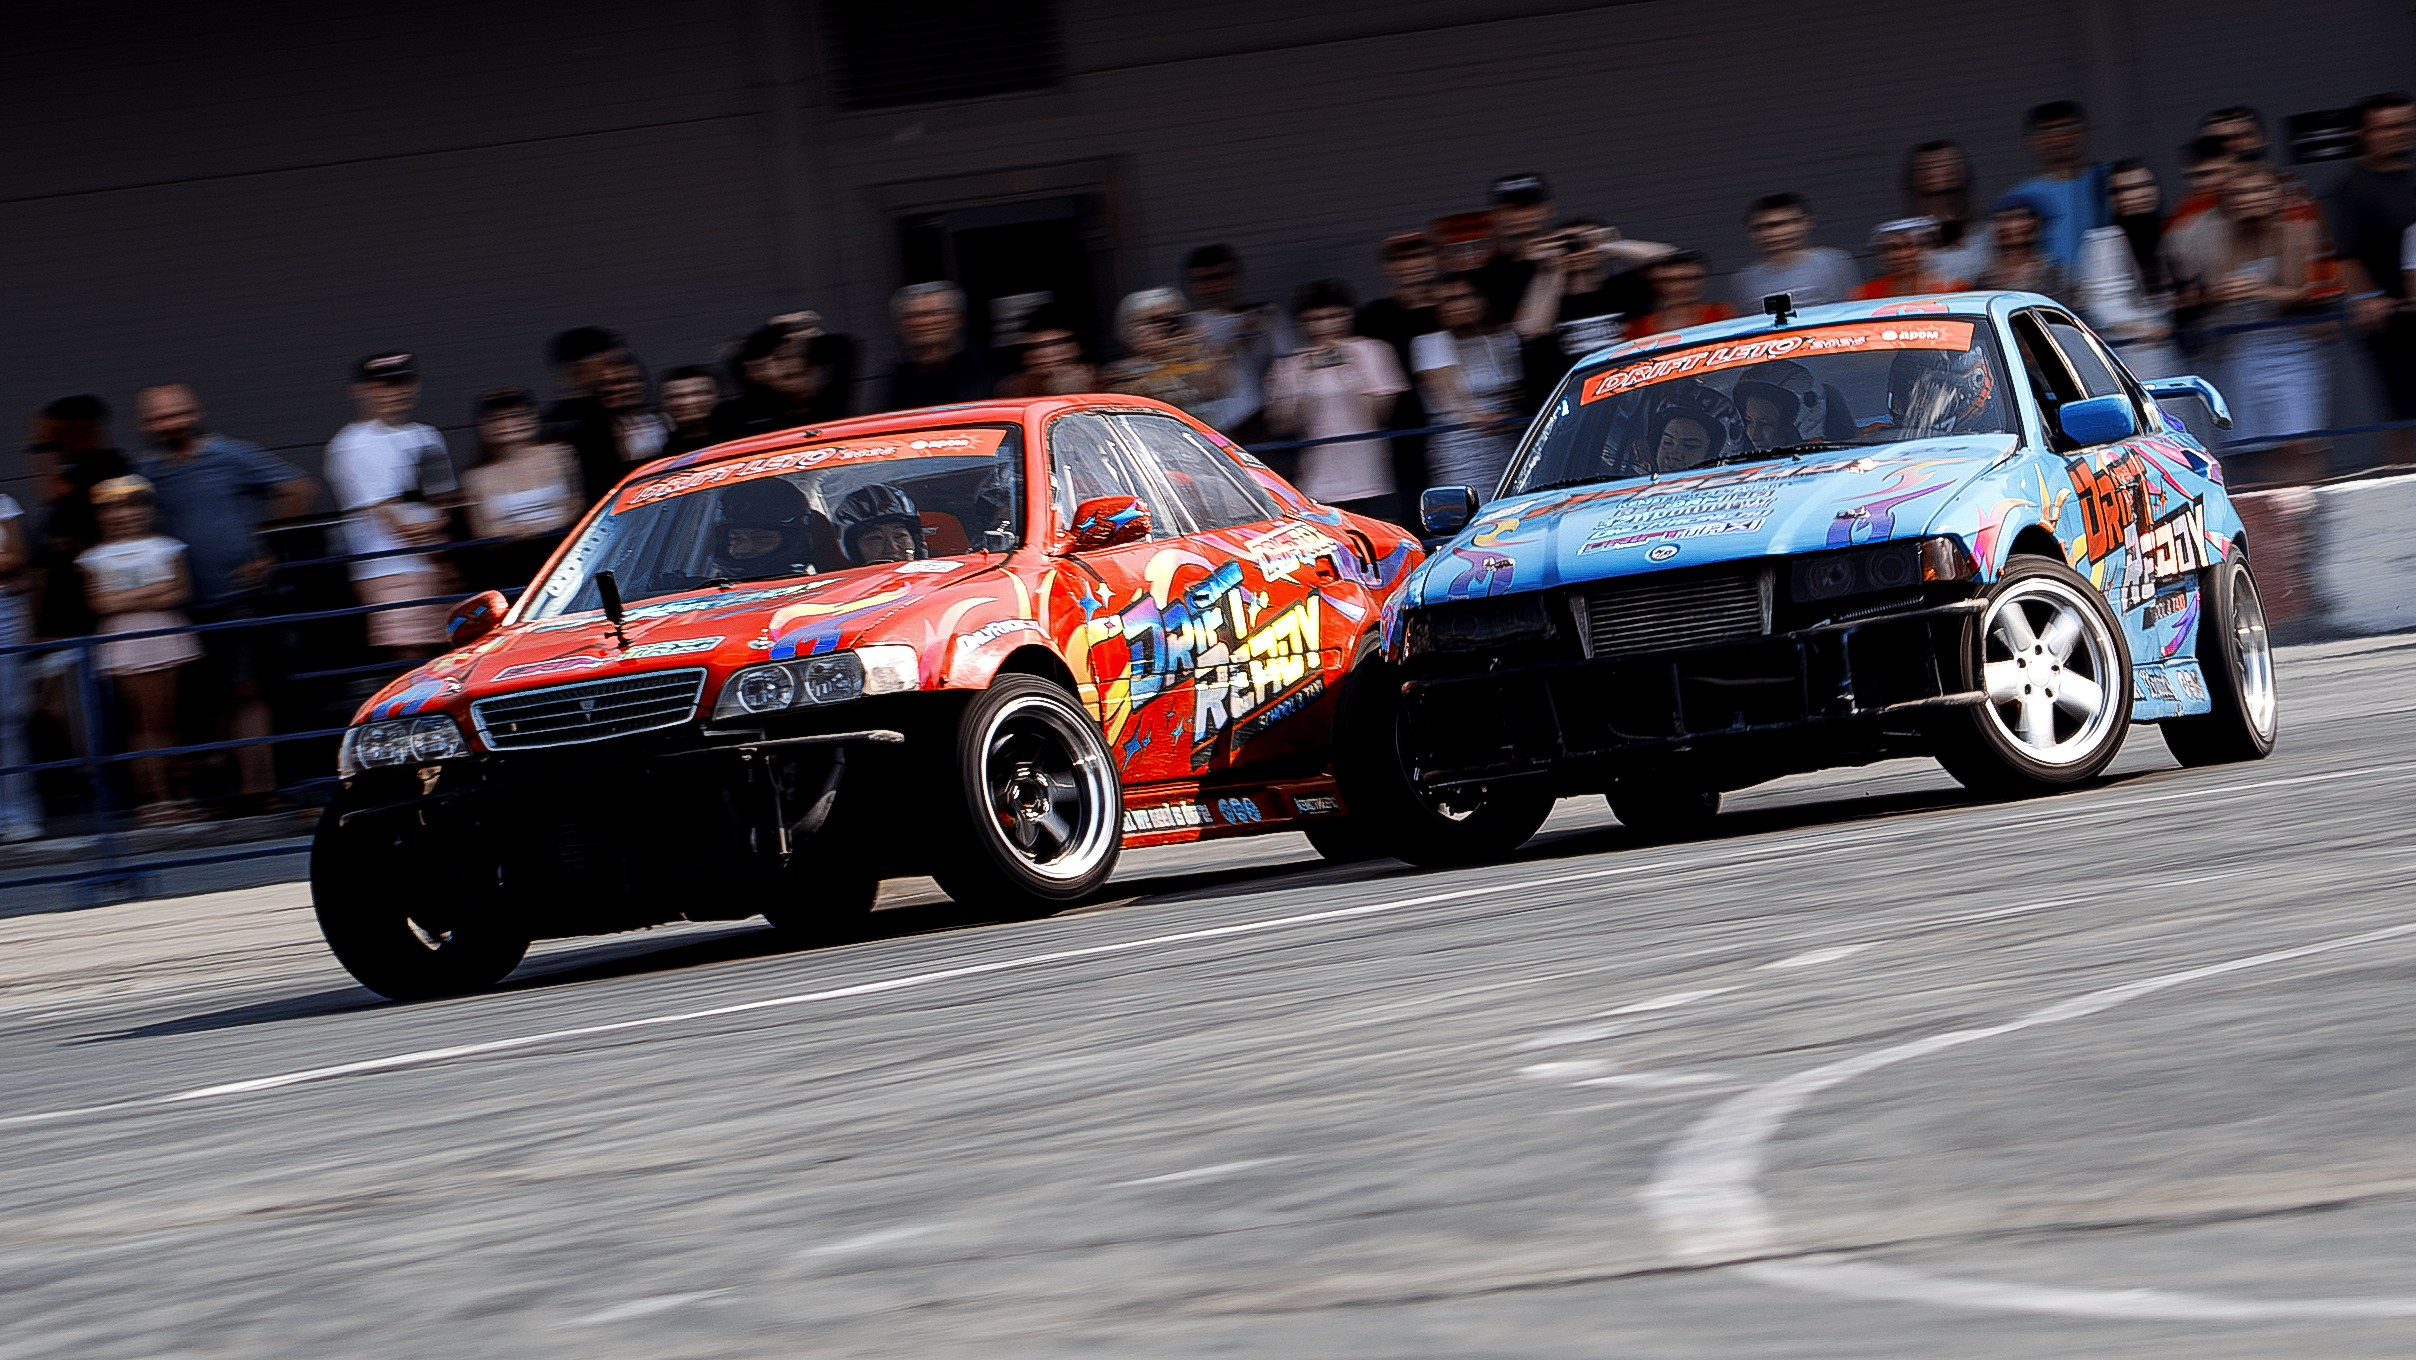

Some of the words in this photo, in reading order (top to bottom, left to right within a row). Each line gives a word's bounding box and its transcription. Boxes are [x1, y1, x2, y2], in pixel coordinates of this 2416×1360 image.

[1596, 352, 1706, 396] DRIFT
[1706, 337, 1803, 367] LETO
[628, 463, 747, 505] DRIFT
[737, 447, 838, 476] LETO
[1120, 558, 1249, 713] DRIFT
